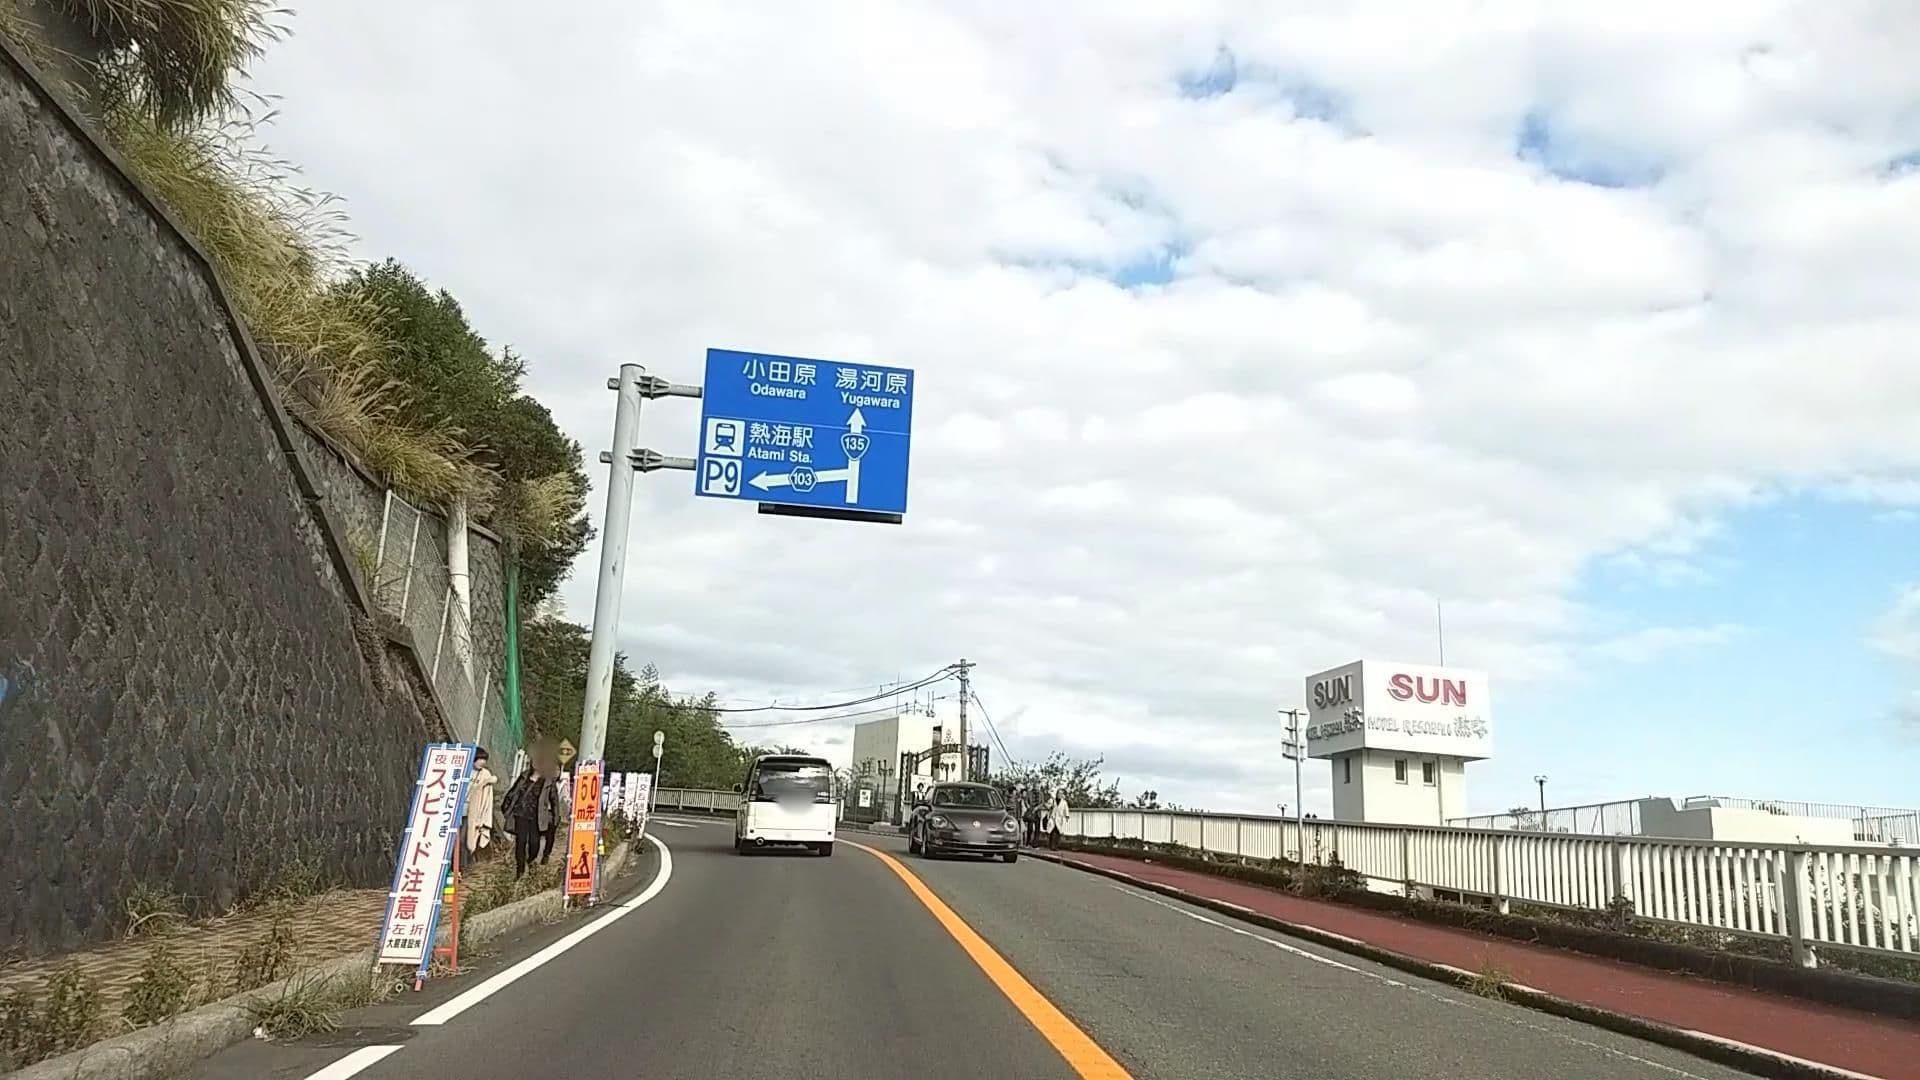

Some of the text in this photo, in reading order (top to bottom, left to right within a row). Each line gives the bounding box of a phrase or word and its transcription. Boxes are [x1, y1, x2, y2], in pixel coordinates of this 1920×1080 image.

[742, 359, 817, 386] 小田原
[834, 367, 908, 395] 湯河原
[750, 383, 807, 400] Odawara
[840, 391, 901, 409] Yugawara
[748, 422, 814, 449] 熱海駅
[845, 437, 865, 451] 135
[747, 446, 813, 464] Atami Sta.
[704, 459, 739, 493] P9
[793, 472, 813, 486] 103
[1313, 673, 1353, 710] SUN
[1387, 673, 1468, 708] SUN
[580, 775, 598, 801] 50
[394, 768, 447, 920] スピード注意
